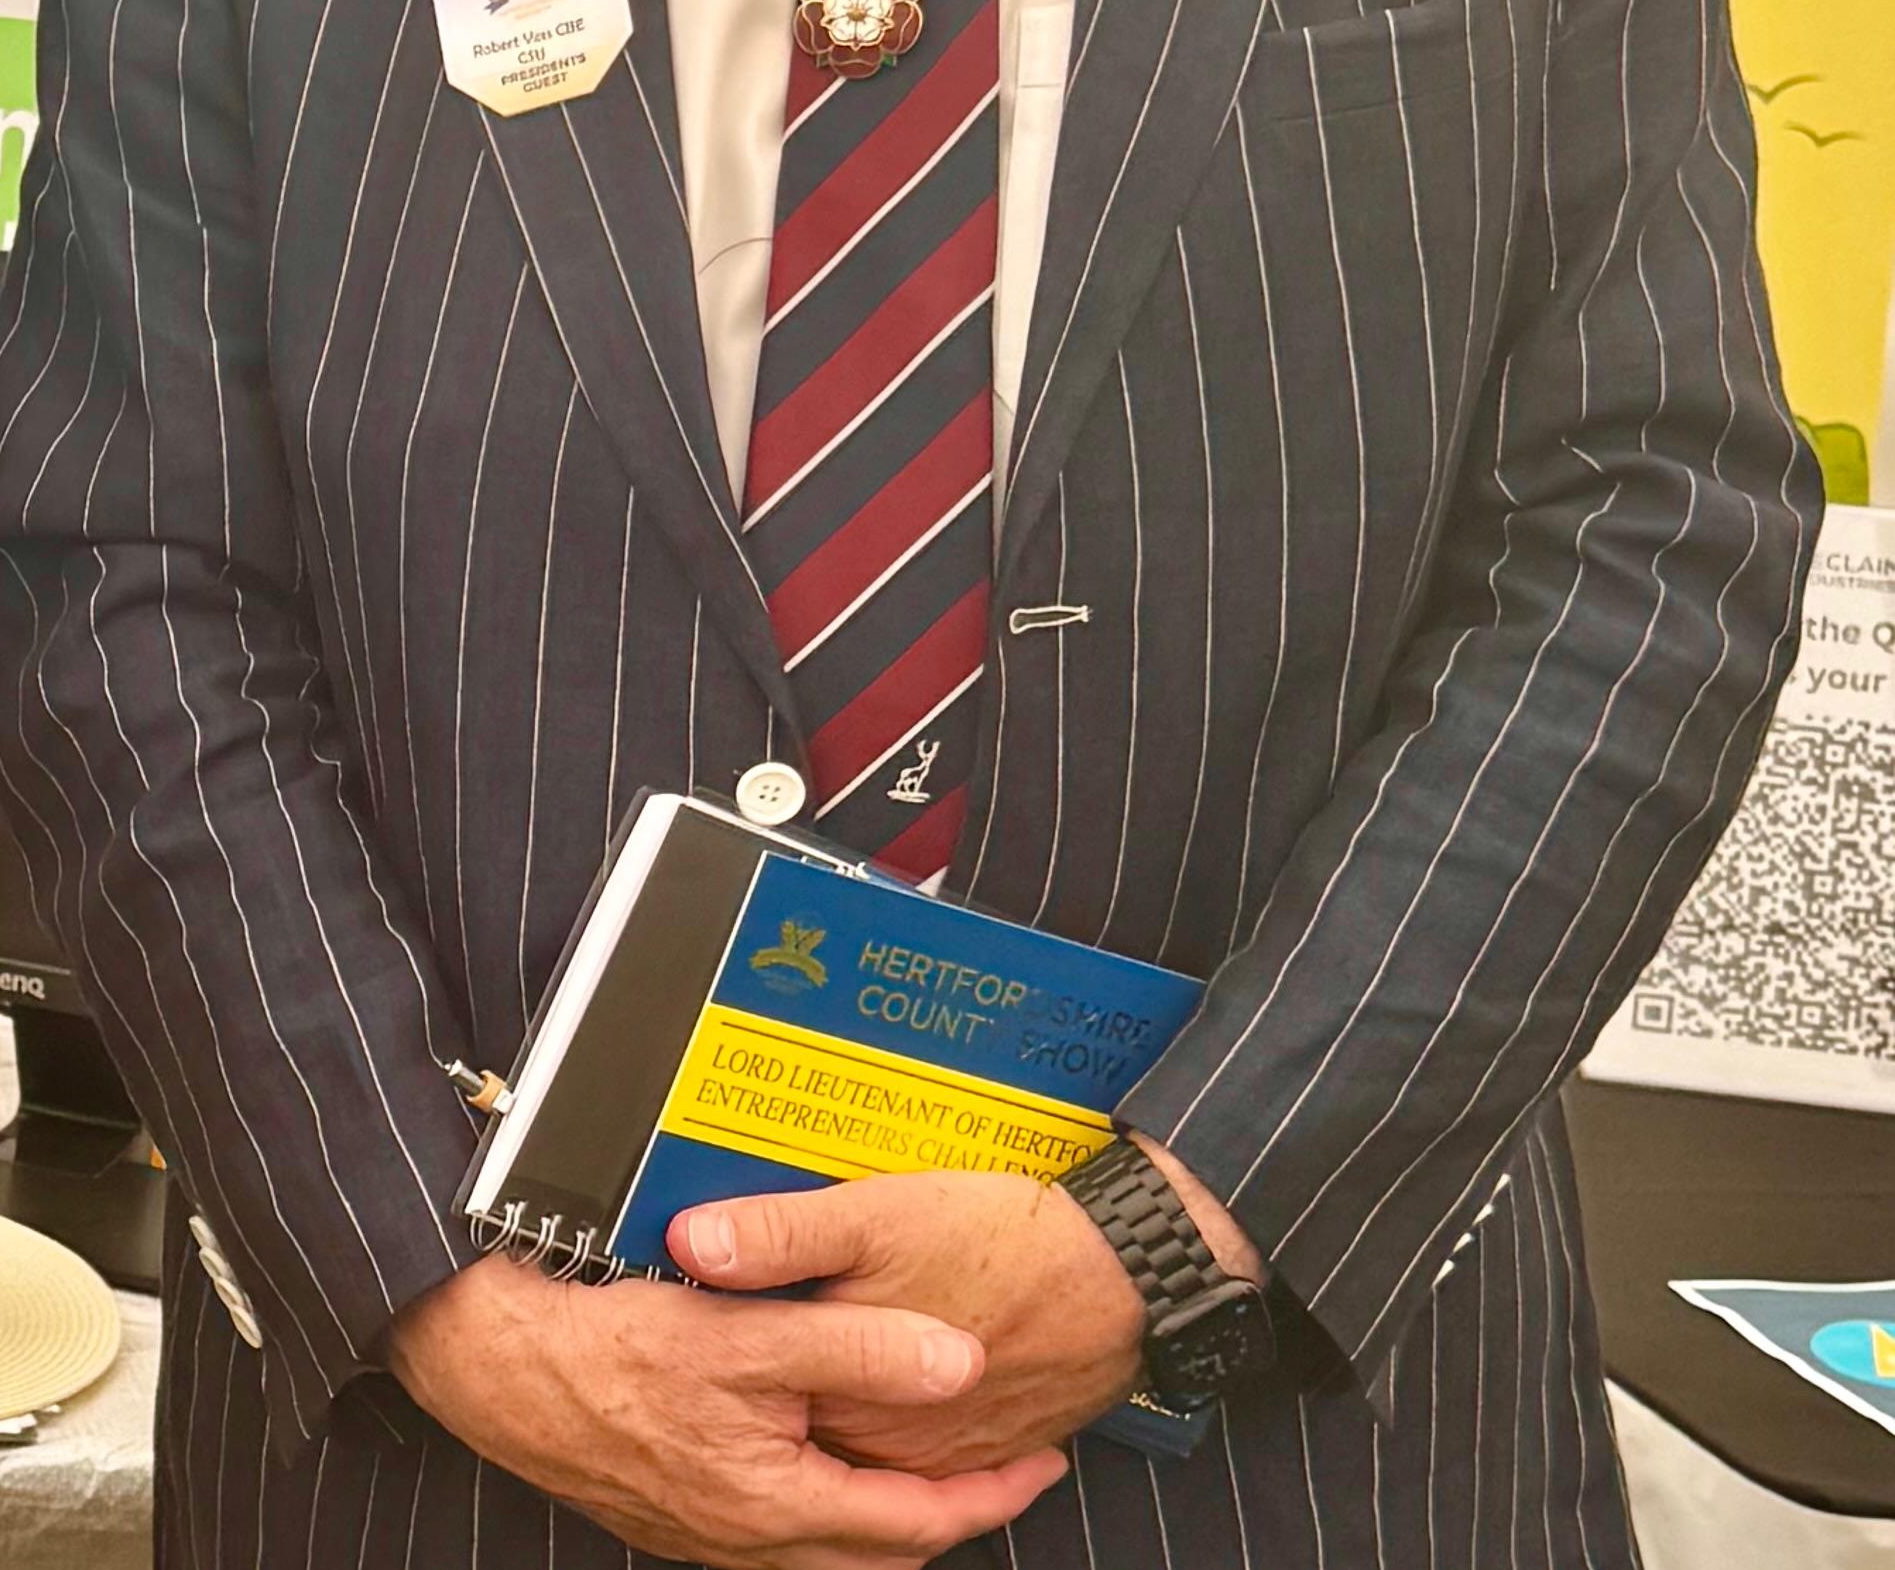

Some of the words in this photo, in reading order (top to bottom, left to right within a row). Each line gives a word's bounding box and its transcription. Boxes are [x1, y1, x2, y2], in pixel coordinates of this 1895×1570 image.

[473, 36, 519, 58] Robert
[1806, 615, 1861, 645] the
[1806, 666, 1887, 694] your
[859, 940, 1151, 1047] HERTFORSHIRE
[857, 984, 994, 1044] COUNT
[1019, 1031, 1125, 1079] SHOW
[696, 1081, 912, 1156] ENTREPRENEURS
[712, 1042, 784, 1084] LORD
[791, 1062, 952, 1129] LIEUTENANT
[955, 1111, 992, 1139] OF
